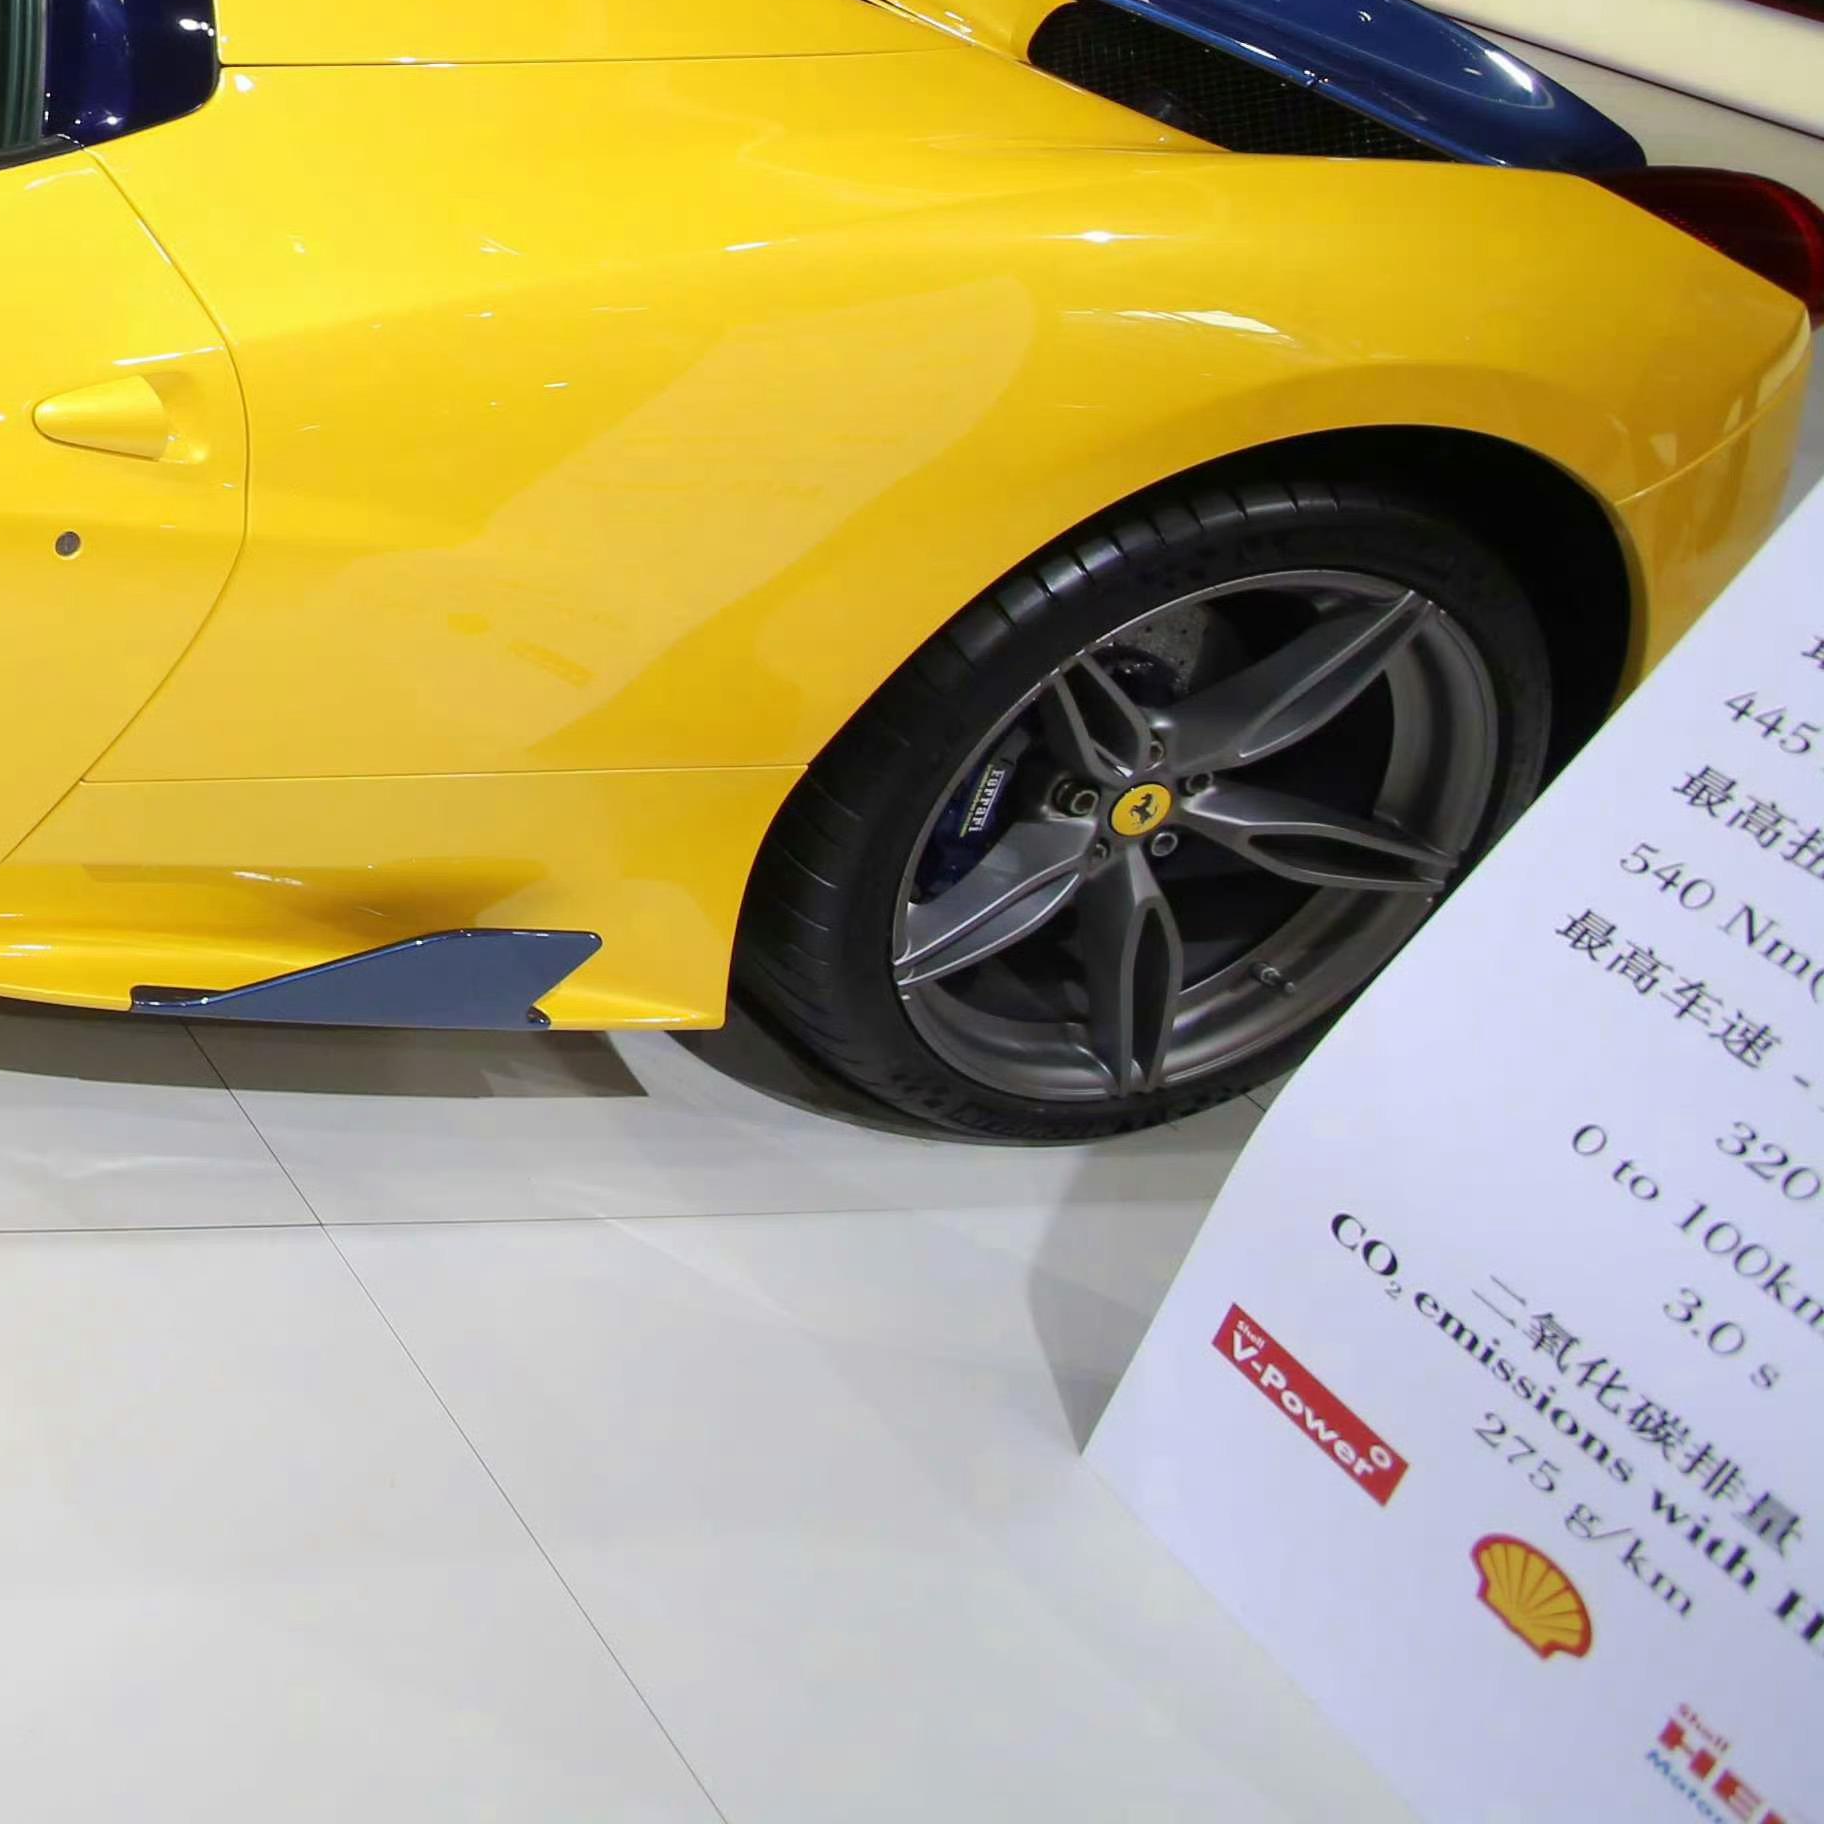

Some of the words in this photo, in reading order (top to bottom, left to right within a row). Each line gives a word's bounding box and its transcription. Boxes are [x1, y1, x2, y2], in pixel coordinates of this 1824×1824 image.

[1723, 690, 1822, 755] 445
[967, 768, 1006, 832] Ferrari
[1617, 841, 1716, 912] 540
[1554, 909, 1783, 1070] 最高车速
[1612, 1159, 1660, 1201] to
[1714, 1120, 1822, 1201] 320
[1236, 1319, 1267, 1350] Shell
[1662, 1287, 1746, 1356] 3.0
[1749, 1362, 1781, 1390] s
[1232, 1329, 1376, 1477] V-Power
[1413, 1291, 1634, 1485] emissions
[1651, 1488, 1757, 1590] with
[1472, 1411, 1562, 1494] 275
[1564, 1502, 1694, 1617] g/km
